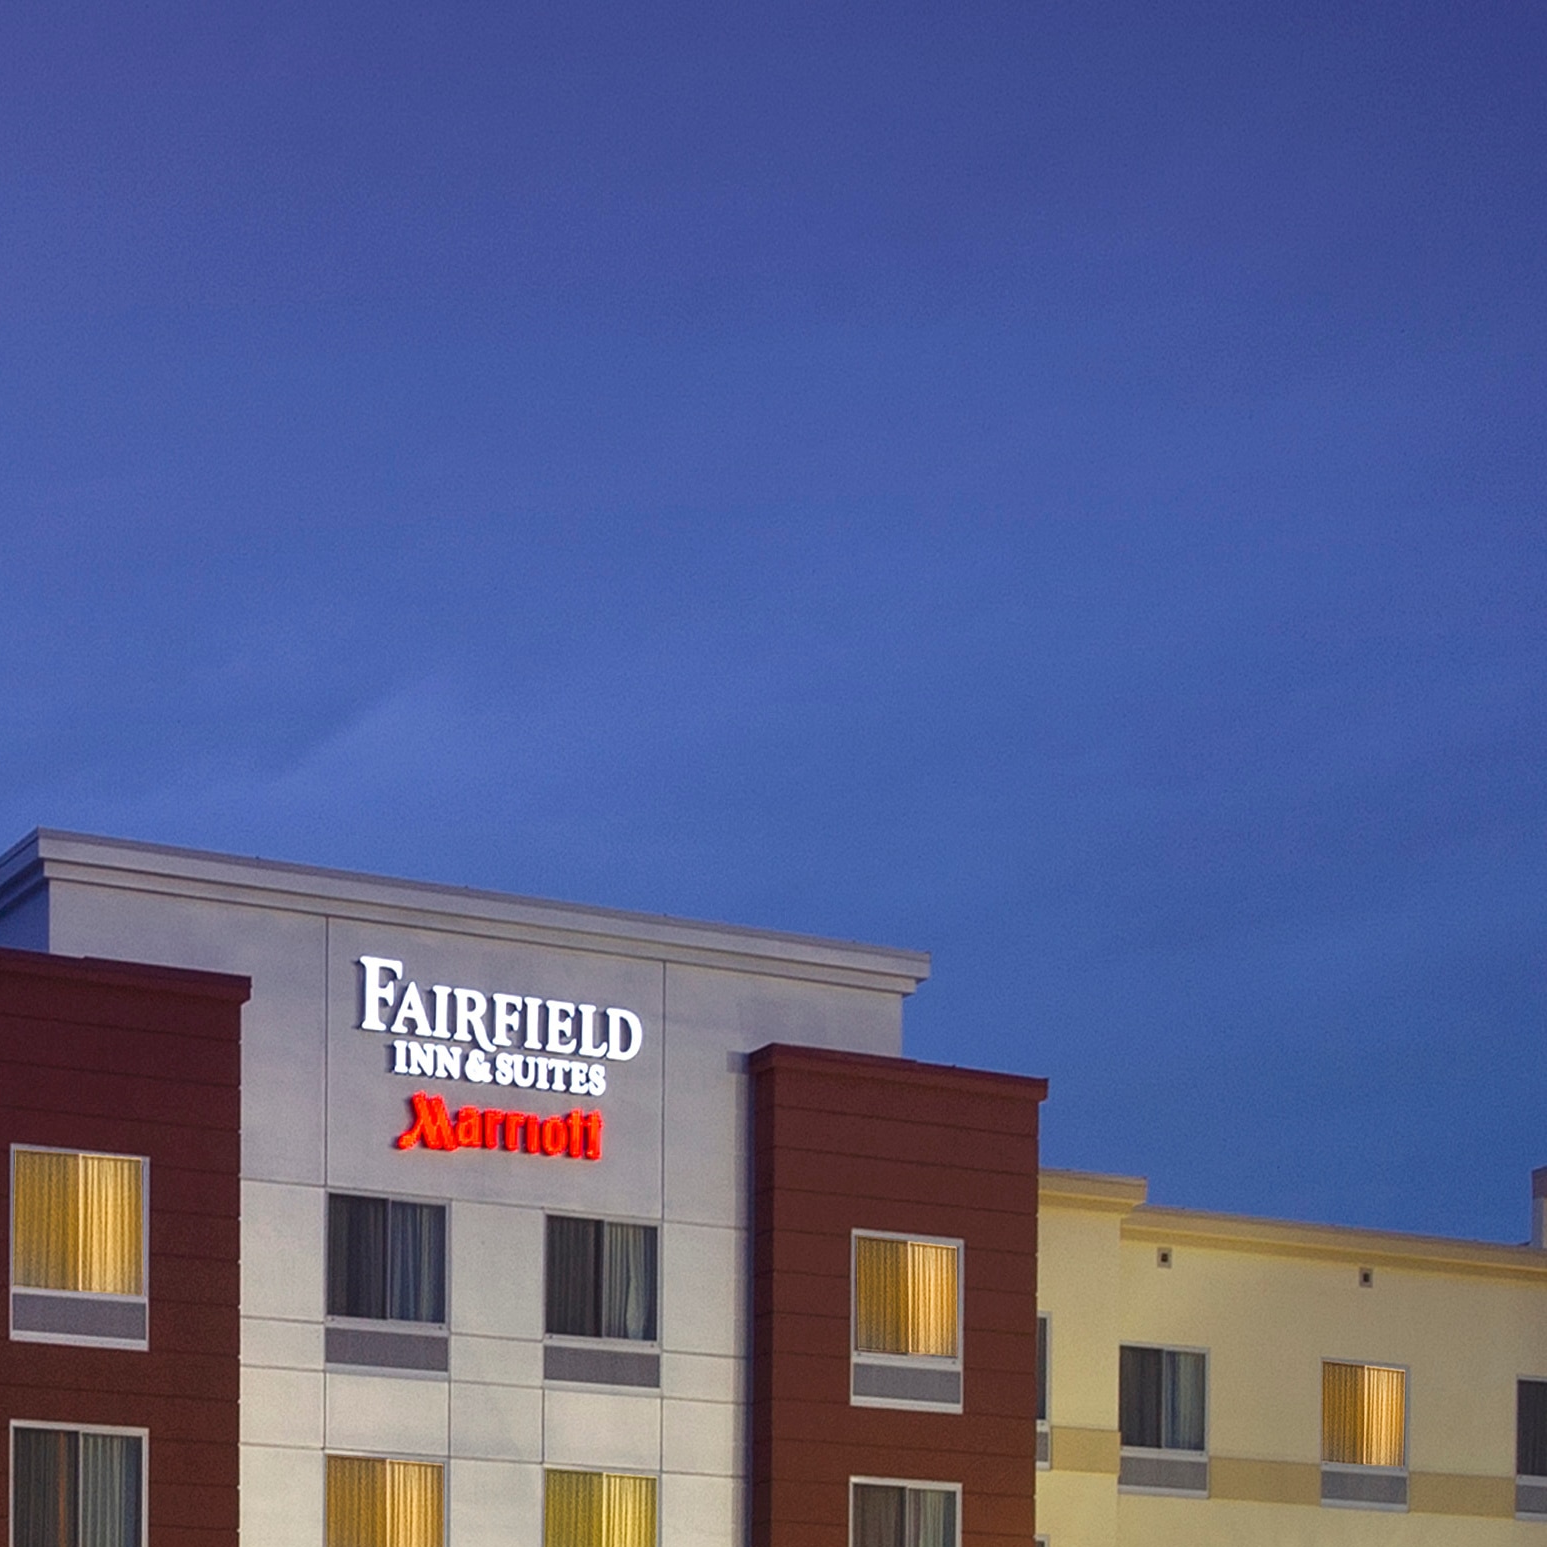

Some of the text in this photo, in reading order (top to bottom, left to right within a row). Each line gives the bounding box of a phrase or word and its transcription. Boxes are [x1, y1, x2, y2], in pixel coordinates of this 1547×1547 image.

[360, 955, 643, 1062] FAIRFIELD
[393, 1040, 607, 1096] INN & SUITES
[397, 1090, 604, 1161] Marriott
